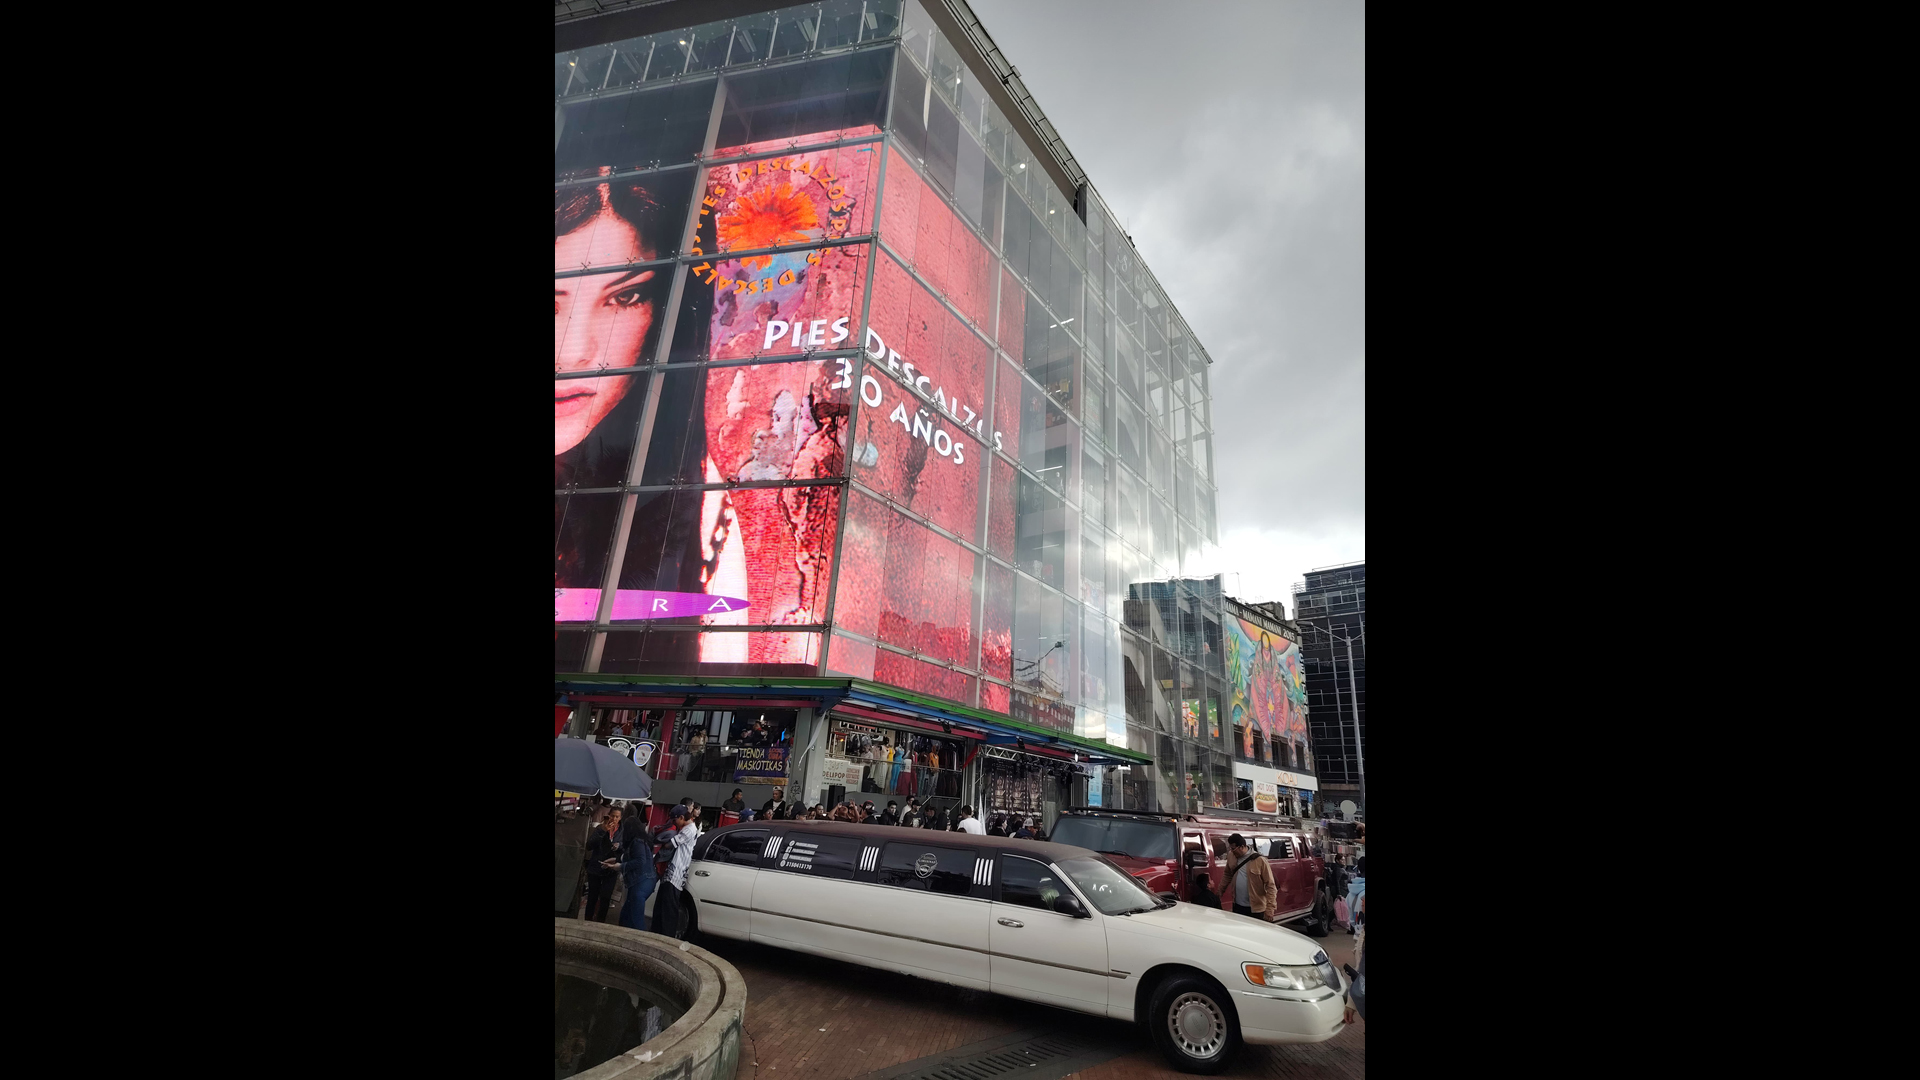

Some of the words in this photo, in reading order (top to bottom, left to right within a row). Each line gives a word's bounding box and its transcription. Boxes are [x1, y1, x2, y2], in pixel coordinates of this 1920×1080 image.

[736, 158, 846, 212] DESCALZOS
[763, 316, 849, 350] PIES
[831, 358, 882, 408] 30
[889, 401, 964, 465] AÑOS
[739, 748, 765, 759] TIENDA
[737, 760, 783, 771] MASKOTIKAS
[1276, 772, 1298, 786] KOAJ
[1265, 784, 1275, 792] DOG
